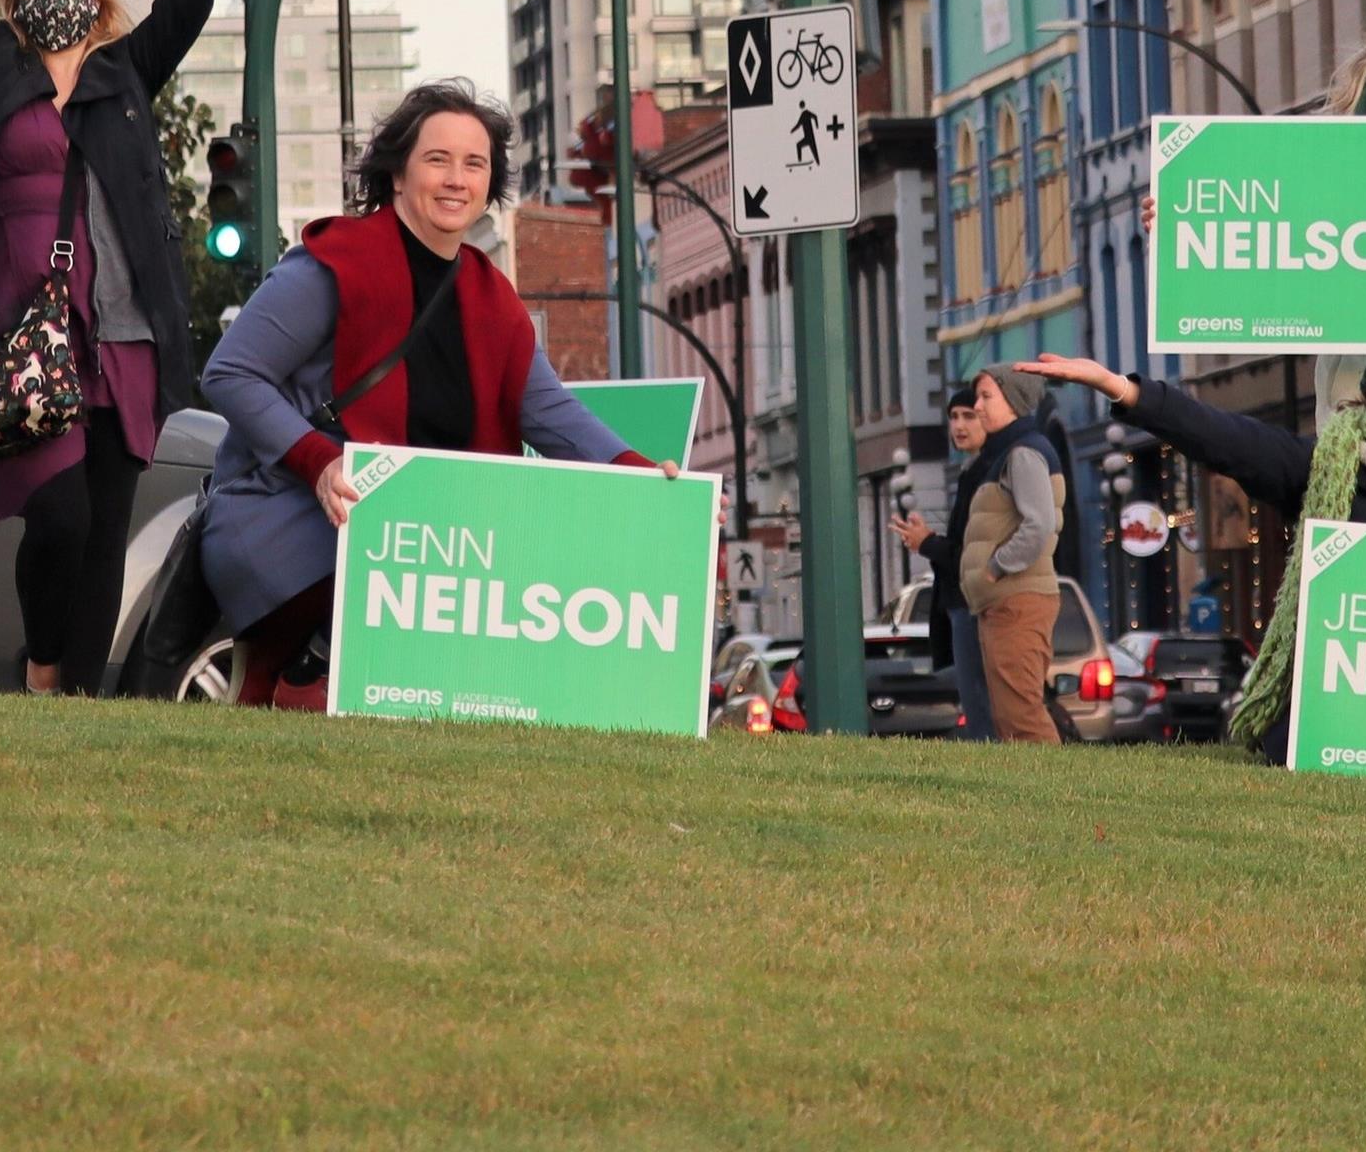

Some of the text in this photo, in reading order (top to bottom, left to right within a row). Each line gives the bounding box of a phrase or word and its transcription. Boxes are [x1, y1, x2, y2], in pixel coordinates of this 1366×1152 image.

[1161, 123, 1195, 158] ELECT
[1174, 179, 1280, 214] JENN
[1178, 317, 1244, 335] greens
[1251, 326, 1324, 337] FURSTENAU
[354, 454, 398, 495] ELECT
[366, 522, 494, 570] JENN
[1313, 530, 1353, 568] ELECT
[365, 570, 678, 652] NEILSON
[365, 684, 443, 706] greens
